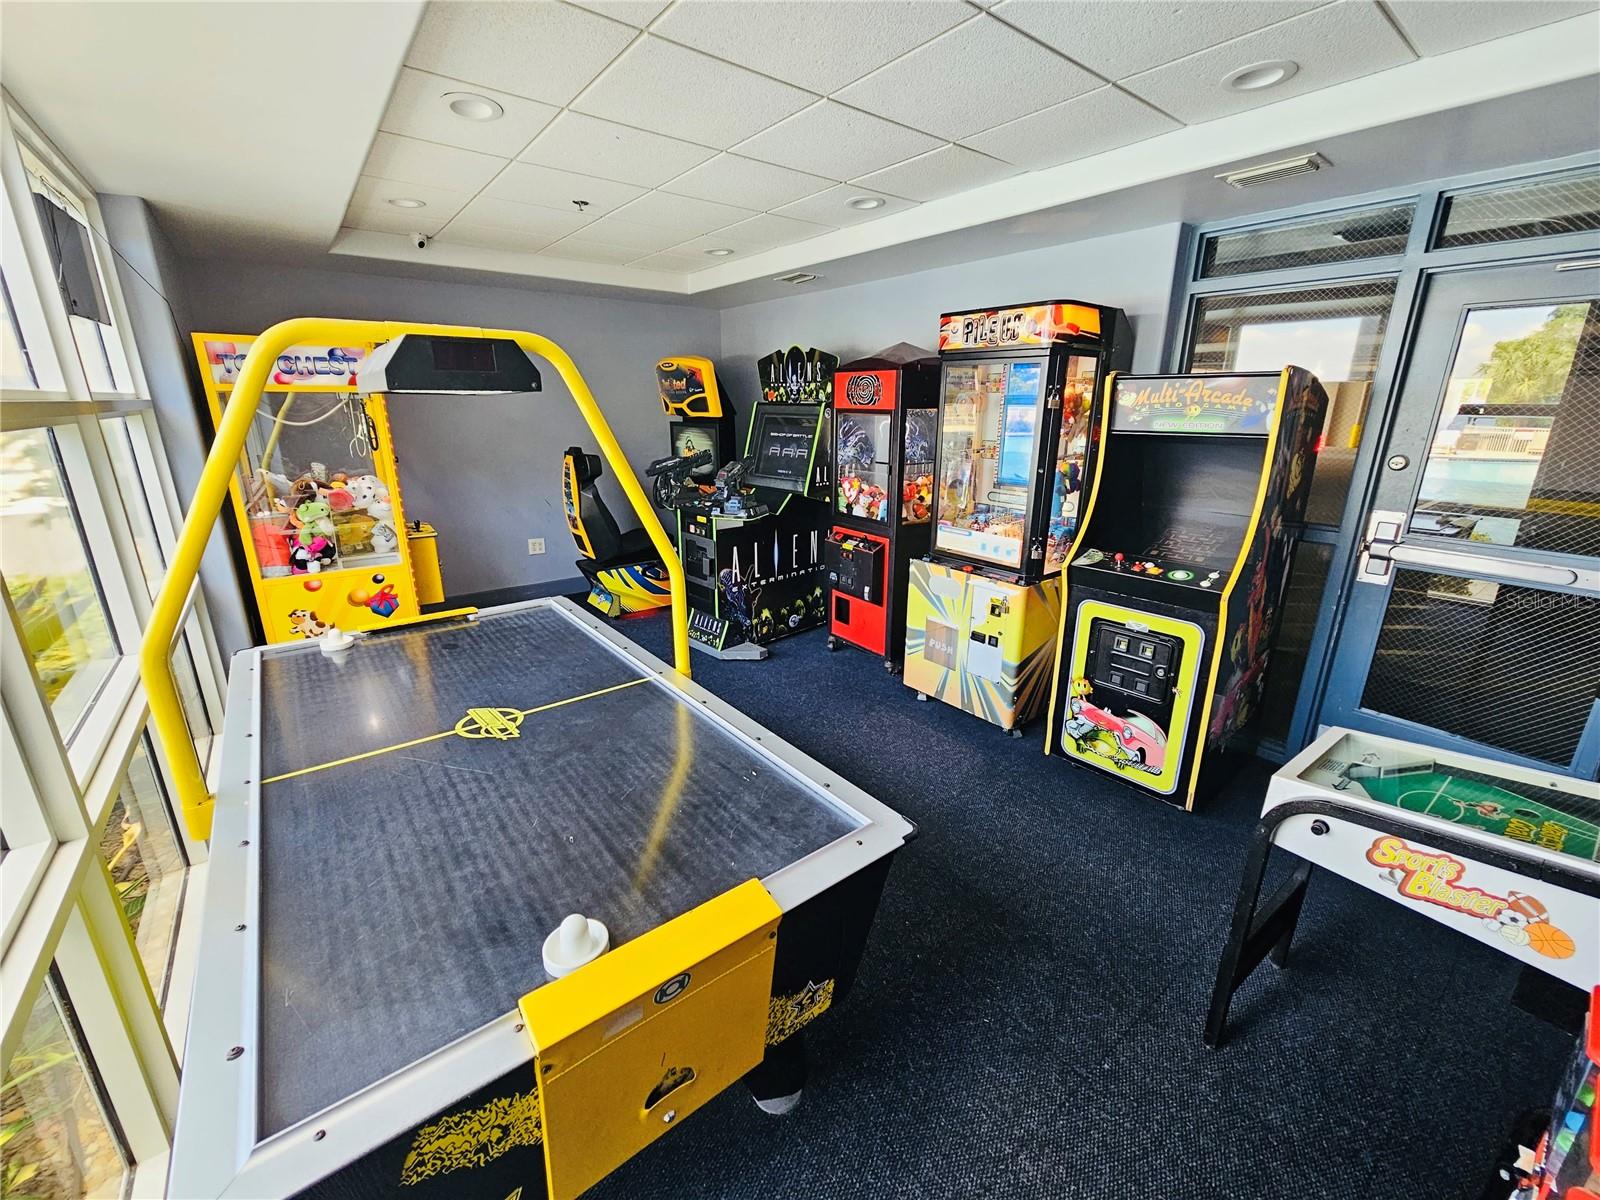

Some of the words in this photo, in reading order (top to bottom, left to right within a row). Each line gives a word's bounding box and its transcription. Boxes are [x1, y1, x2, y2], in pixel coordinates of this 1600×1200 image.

[277, 354, 358, 376] CHEST
[1131, 379, 1253, 407] Multi-Arcade
[1153, 421, 1179, 429] NEW
[1182, 421, 1224, 430] EDITION
[731, 528, 829, 584] ALIEN
[731, 564, 826, 593] EXTERMINATIO
[928, 638, 954, 656] PUSH
[1373, 838, 1461, 880] Sports
[1405, 871, 1509, 917] Blaster
